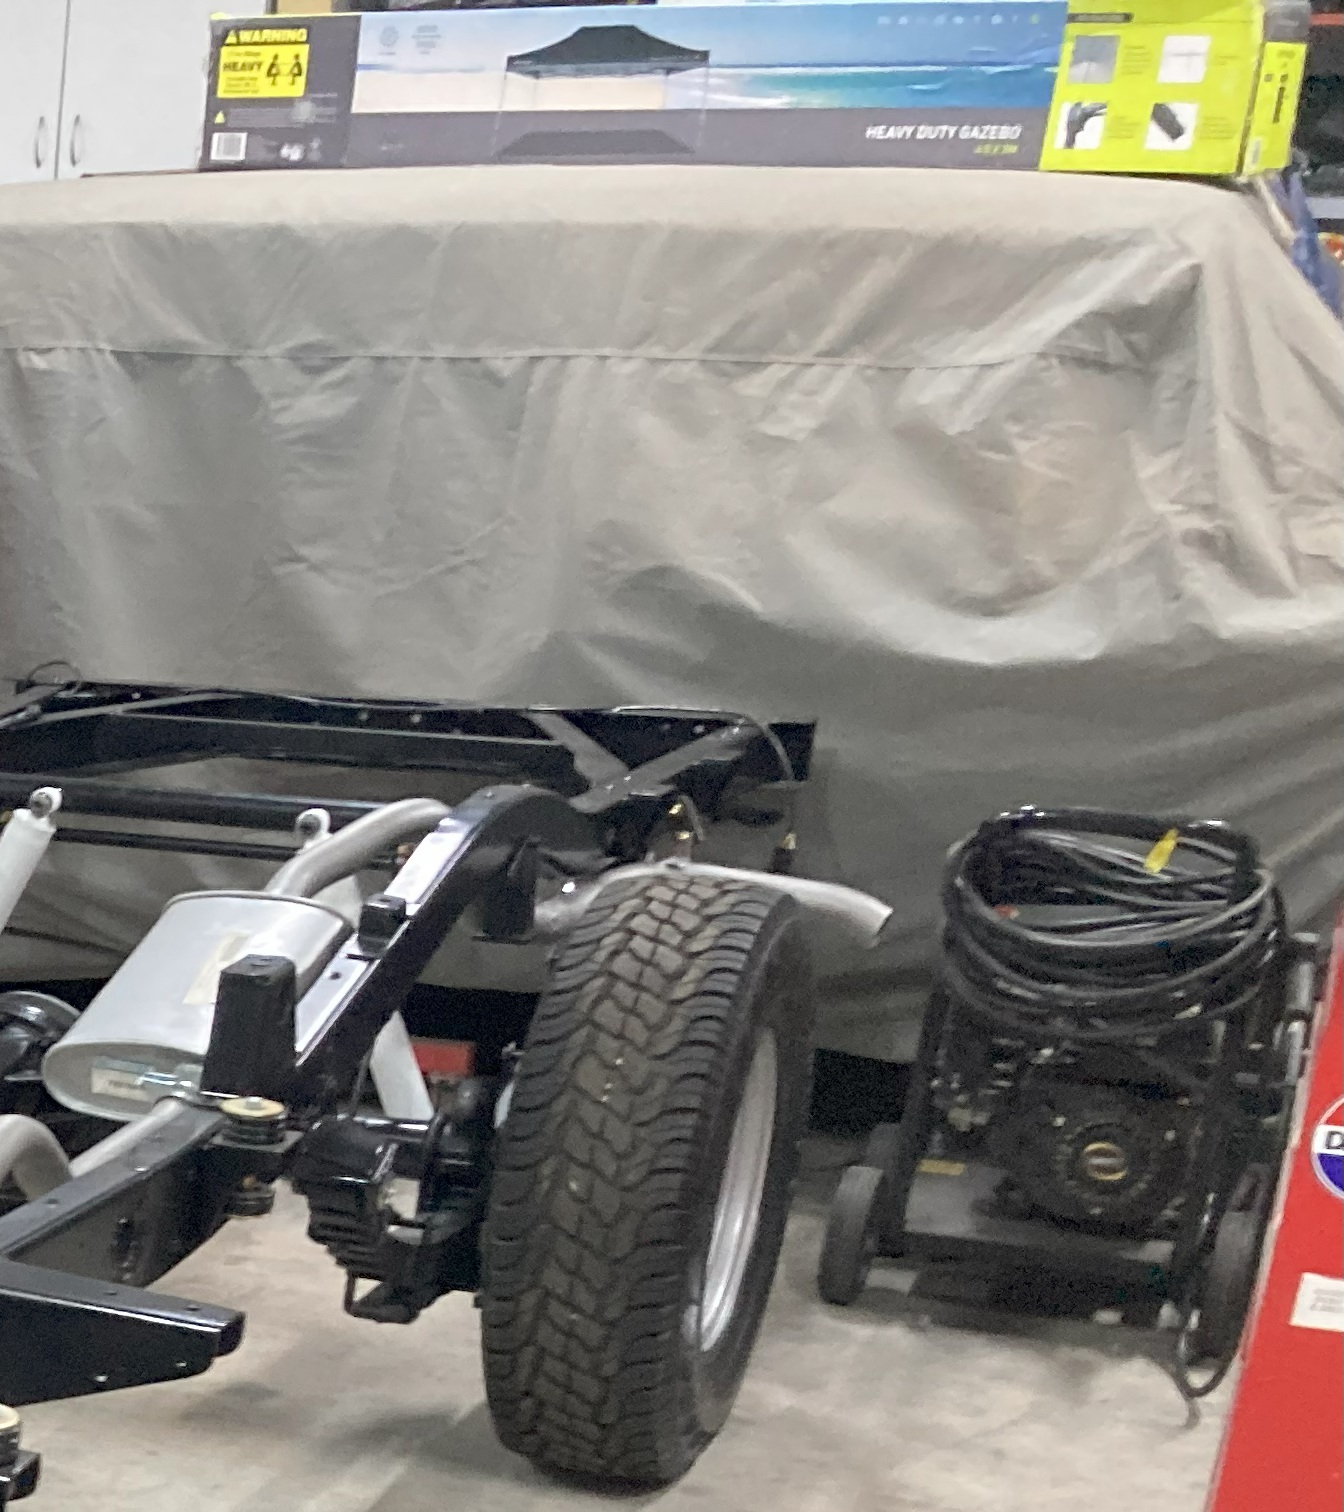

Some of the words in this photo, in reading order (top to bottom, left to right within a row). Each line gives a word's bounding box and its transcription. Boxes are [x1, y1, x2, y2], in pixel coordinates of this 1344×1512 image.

[238, 28, 308, 43] WARNING
[222, 61, 263, 72] HEAVY
[864, 124, 916, 140] HEAVY
[915, 124, 959, 140] DUTY
[958, 123, 1024, 140] GAZEBO
